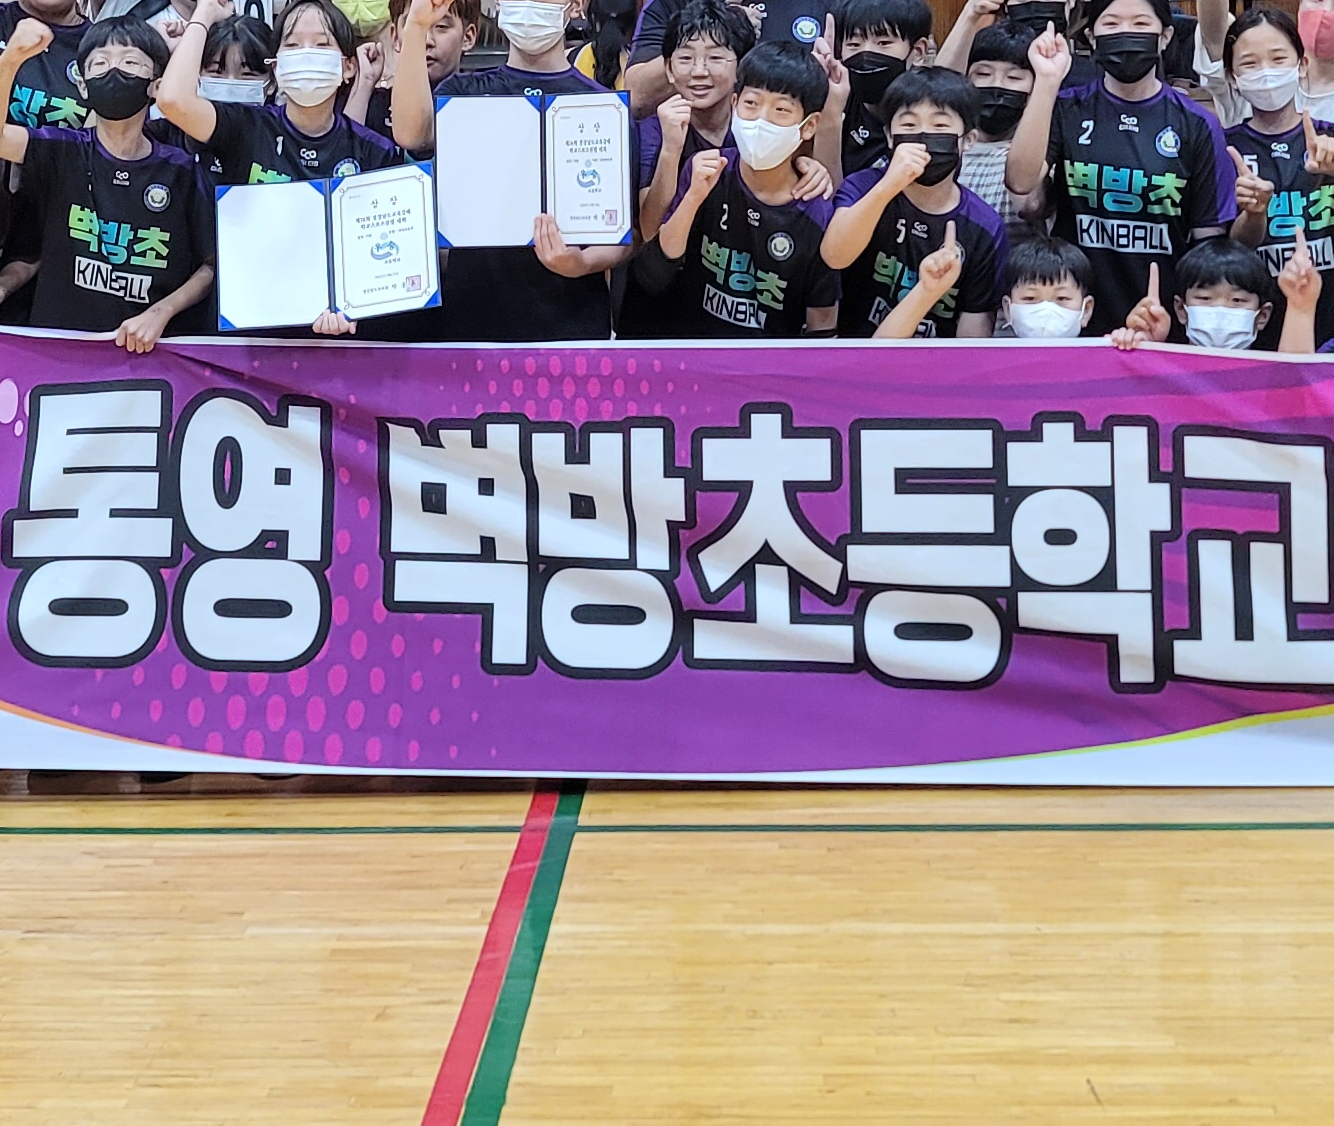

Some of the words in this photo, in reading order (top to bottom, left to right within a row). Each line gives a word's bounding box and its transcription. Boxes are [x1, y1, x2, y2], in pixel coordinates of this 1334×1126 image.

[1077, 119, 1094, 145] 2
[1064, 159, 1188, 217] 벽방초
[68, 203, 171, 269] 벽방초
[1078, 217, 1171, 253] KINBALL
[3, 379, 332, 672] 통영
